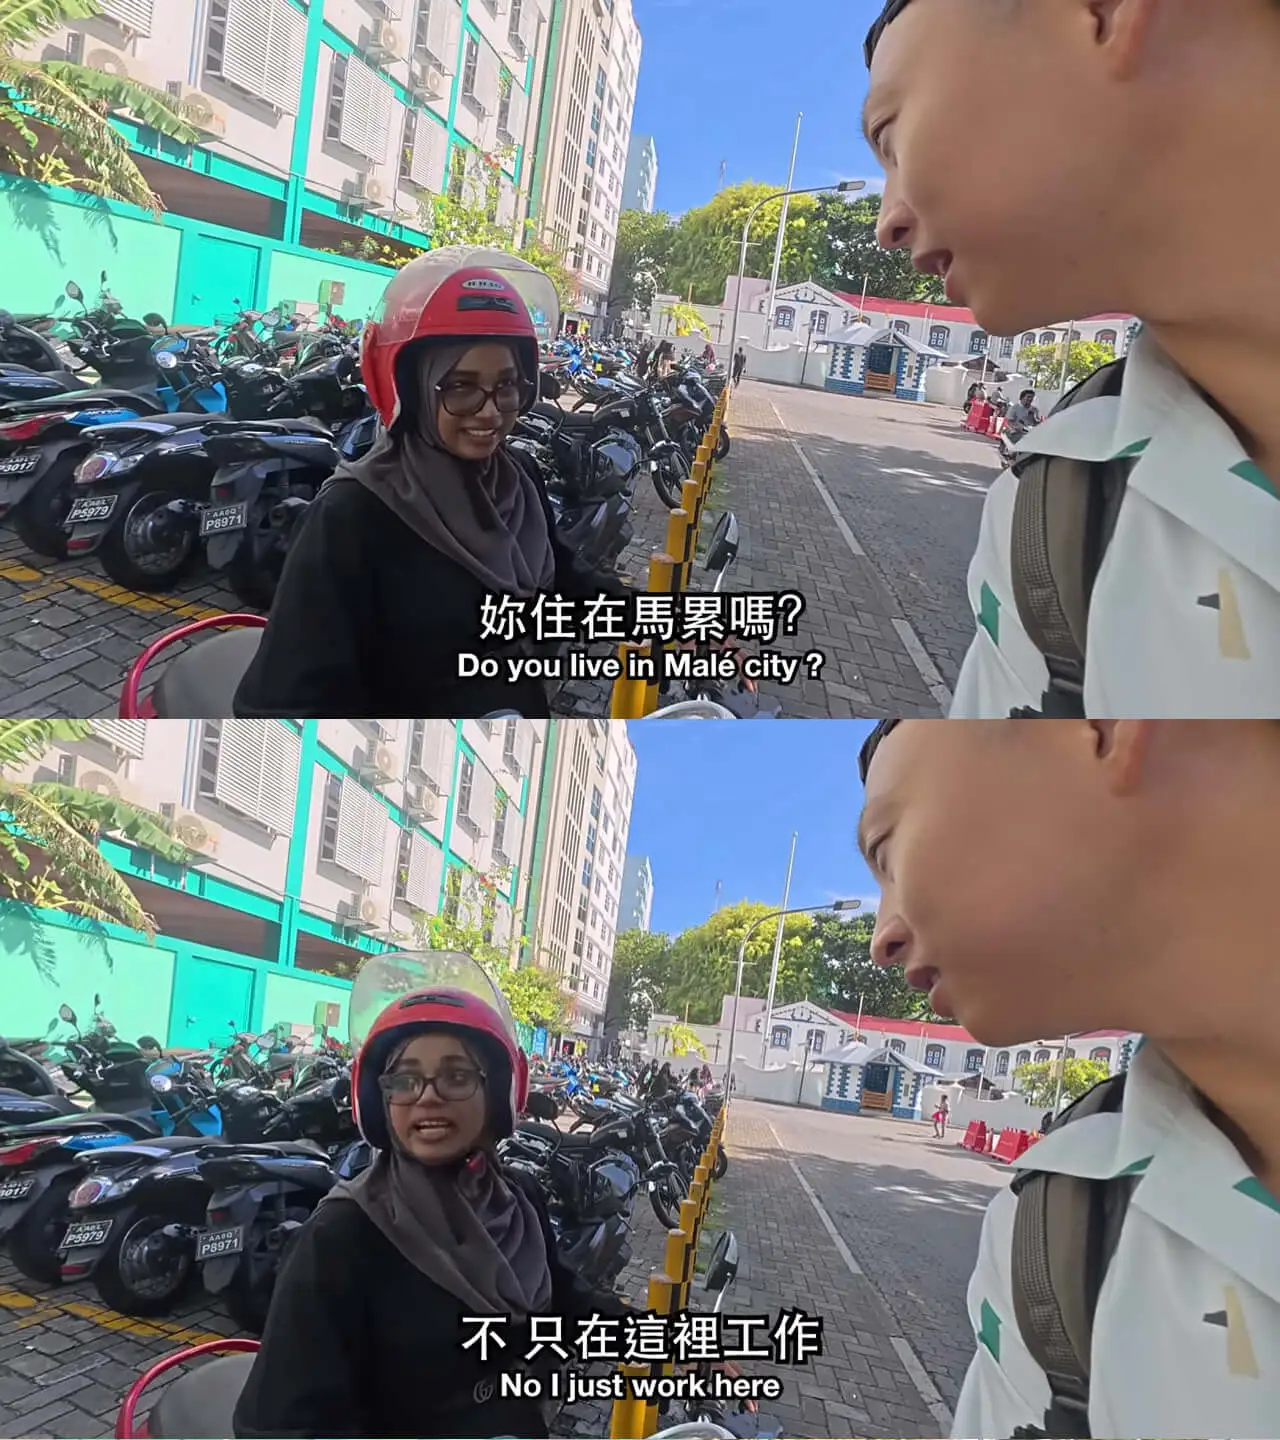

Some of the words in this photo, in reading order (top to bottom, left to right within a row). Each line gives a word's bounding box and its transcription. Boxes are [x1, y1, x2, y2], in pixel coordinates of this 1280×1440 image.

[70, 505, 108, 519] P5979
[205, 514, 242, 530] P8971
[65, 1231, 104, 1245] P5979
[202, 1238, 239, 1254] P8971
